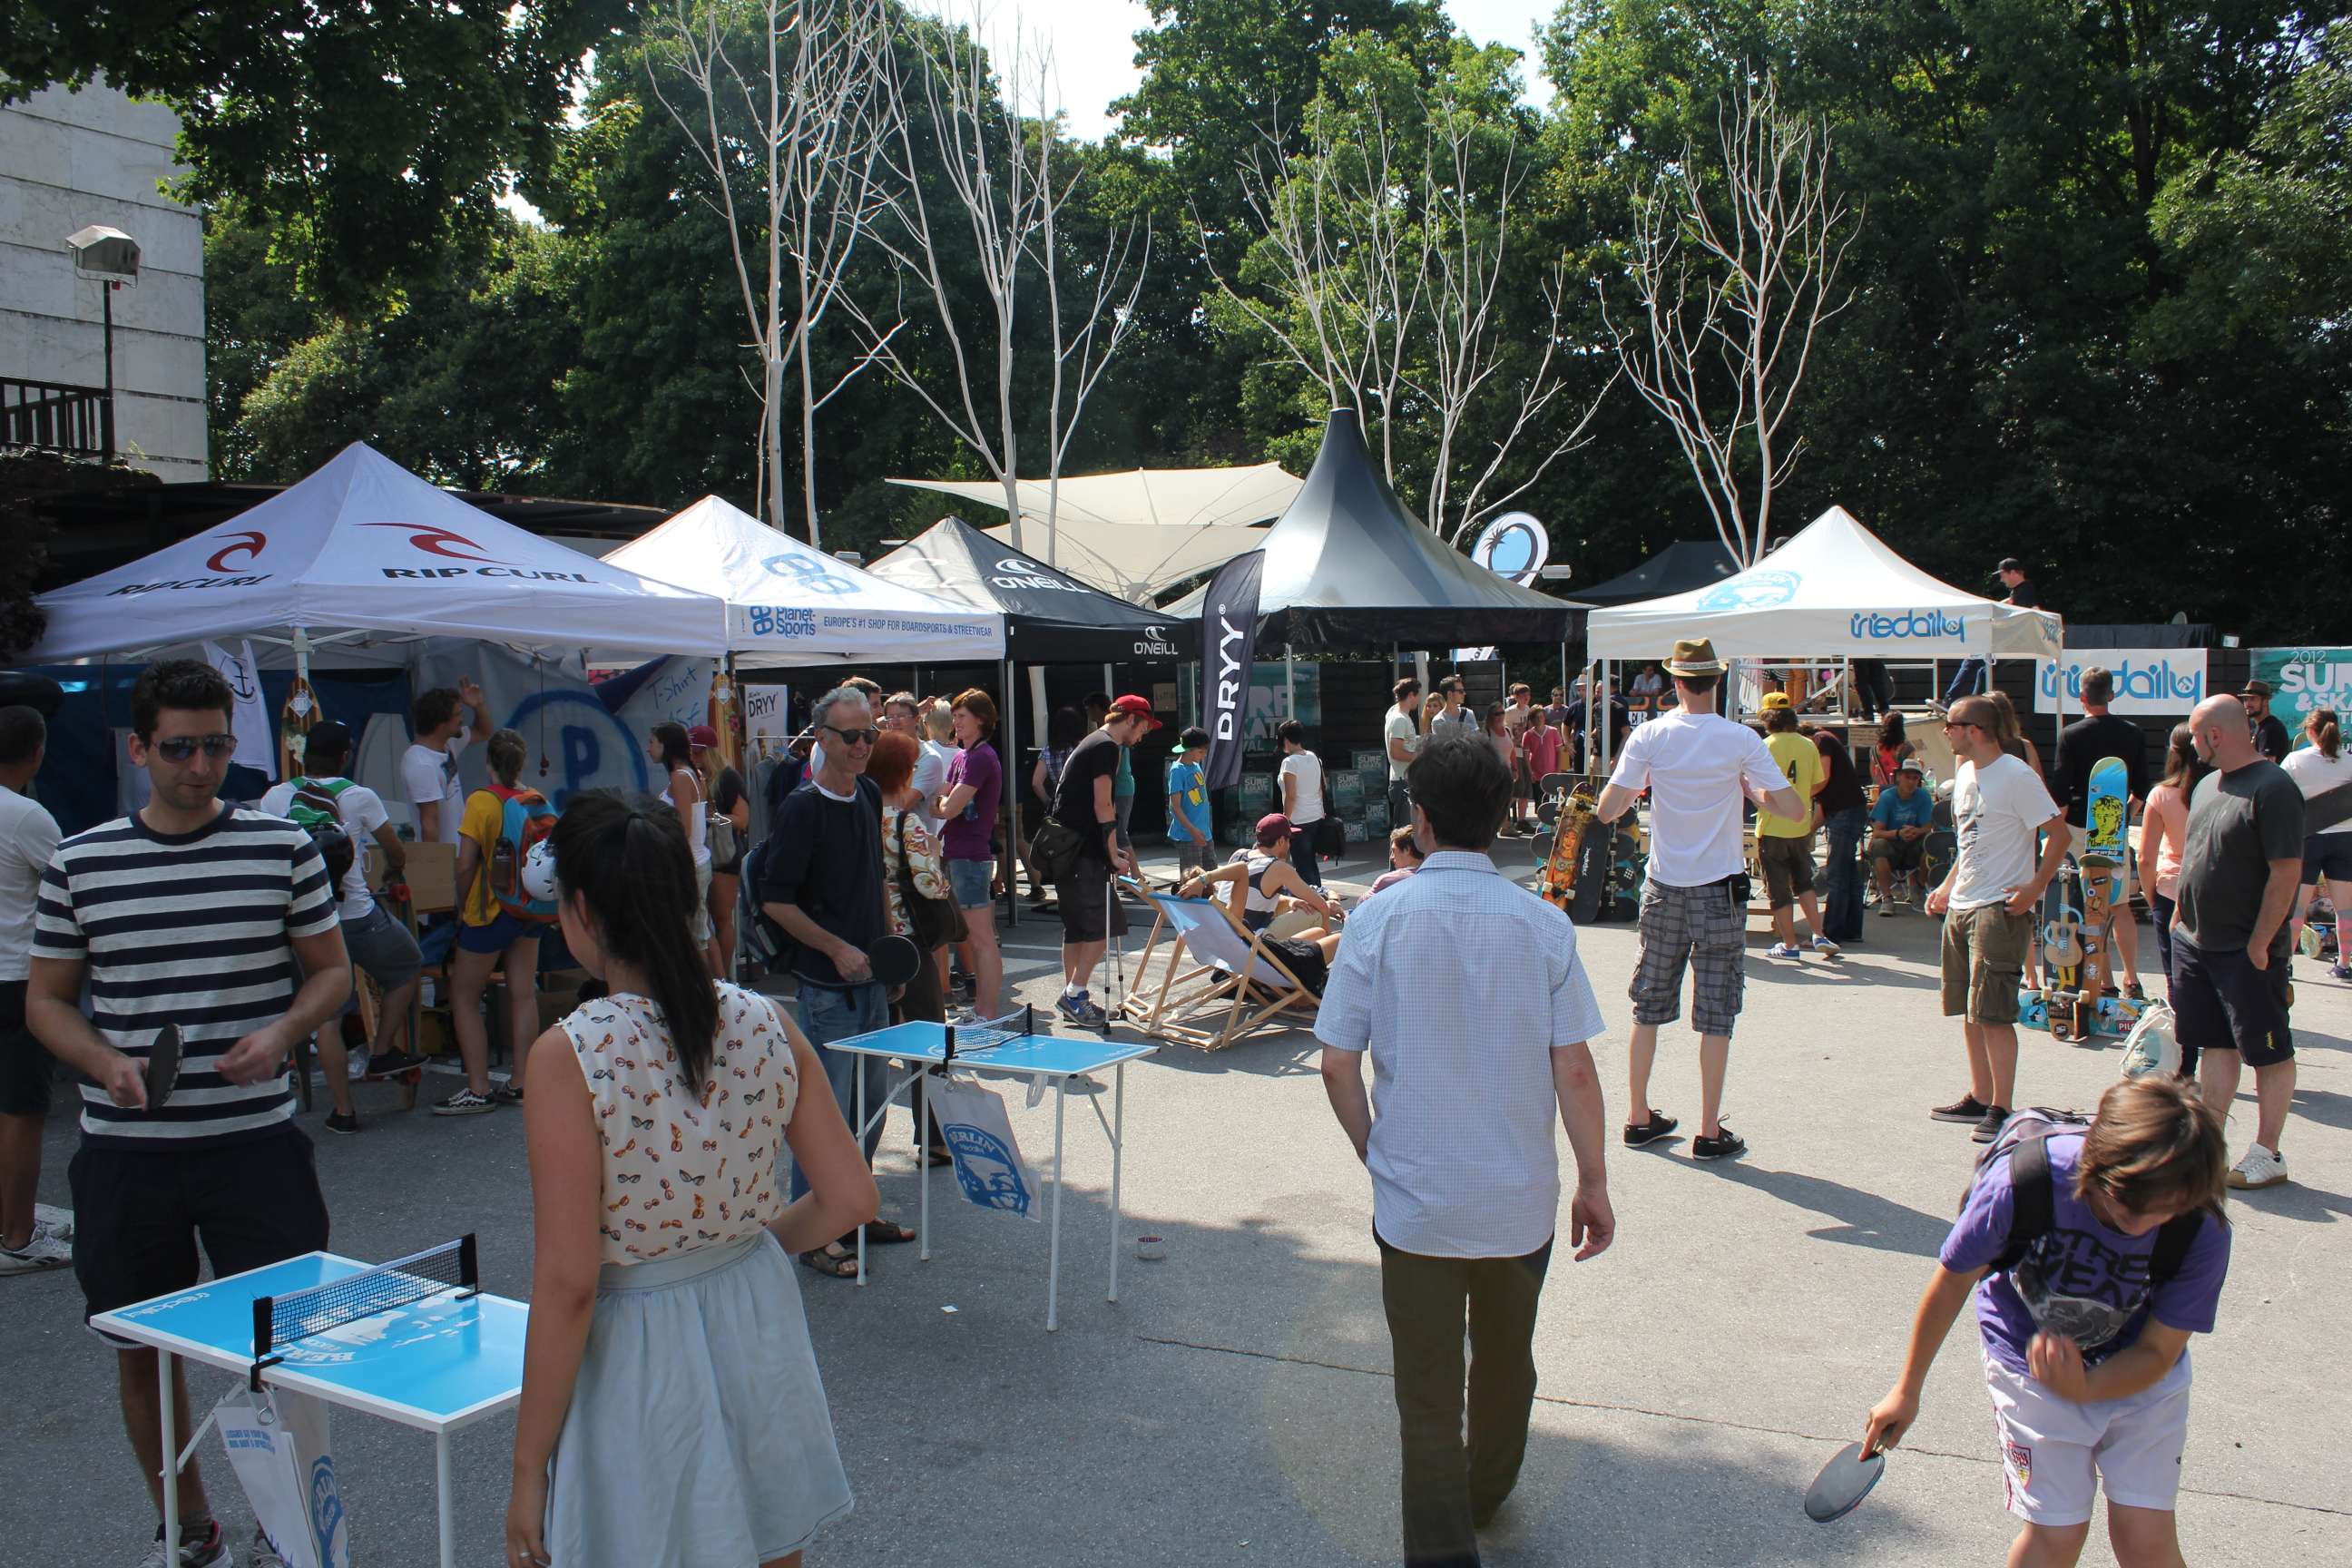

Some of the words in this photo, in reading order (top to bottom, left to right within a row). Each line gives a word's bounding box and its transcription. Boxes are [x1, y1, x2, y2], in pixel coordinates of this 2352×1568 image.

[170, 573, 273, 590] CURL
[382, 567, 468, 579] RIP
[476, 567, 599, 584] CURL
[992, 576, 1092, 593] O'NEILL
[776, 618, 817, 638] Sports
[823, 616, 857, 628] EUROPE'S
[858, 618, 867, 629] #1
[867, 619, 886, 629] SHOP
[887, 620, 900, 631] FOR
[902, 621, 947, 633] BOARDSPORTS
[947, 624, 953, 633] &
[953, 624, 993, 637] STREETWEAR
[1850, 609, 1965, 643] iriedaily
[1133, 642, 1179, 654] O'NEILL
[2289, 650, 2327, 663] 2012
[2042, 659, 2201, 706] iridaily
[748, 694, 777, 718] DRYY
[2295, 692, 2352, 711] &SK
[1787, 760, 1797, 785] 4
